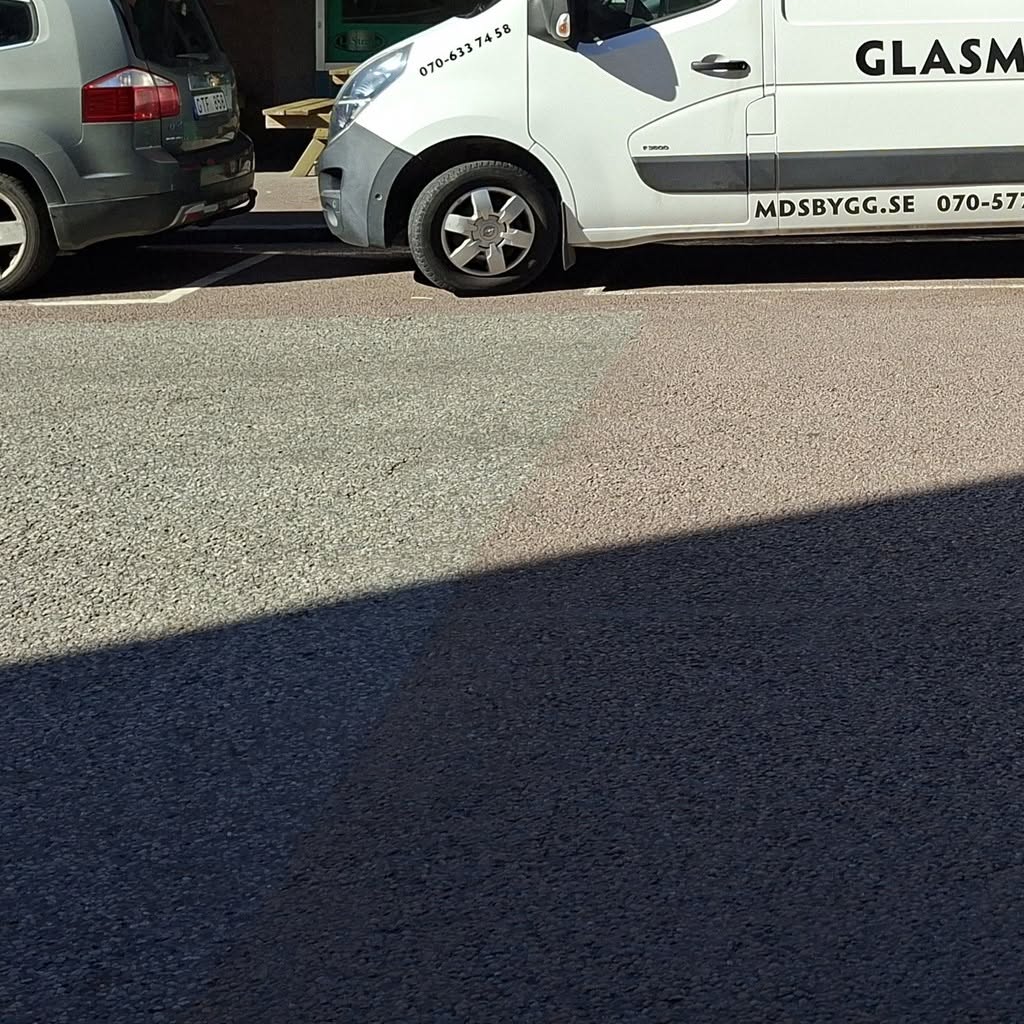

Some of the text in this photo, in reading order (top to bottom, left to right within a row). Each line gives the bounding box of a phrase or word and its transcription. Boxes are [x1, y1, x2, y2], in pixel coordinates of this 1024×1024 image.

[419, 23, 511, 77] 070-633 74 58
[754, 195, 915, 218] MDSBYGG.SE
